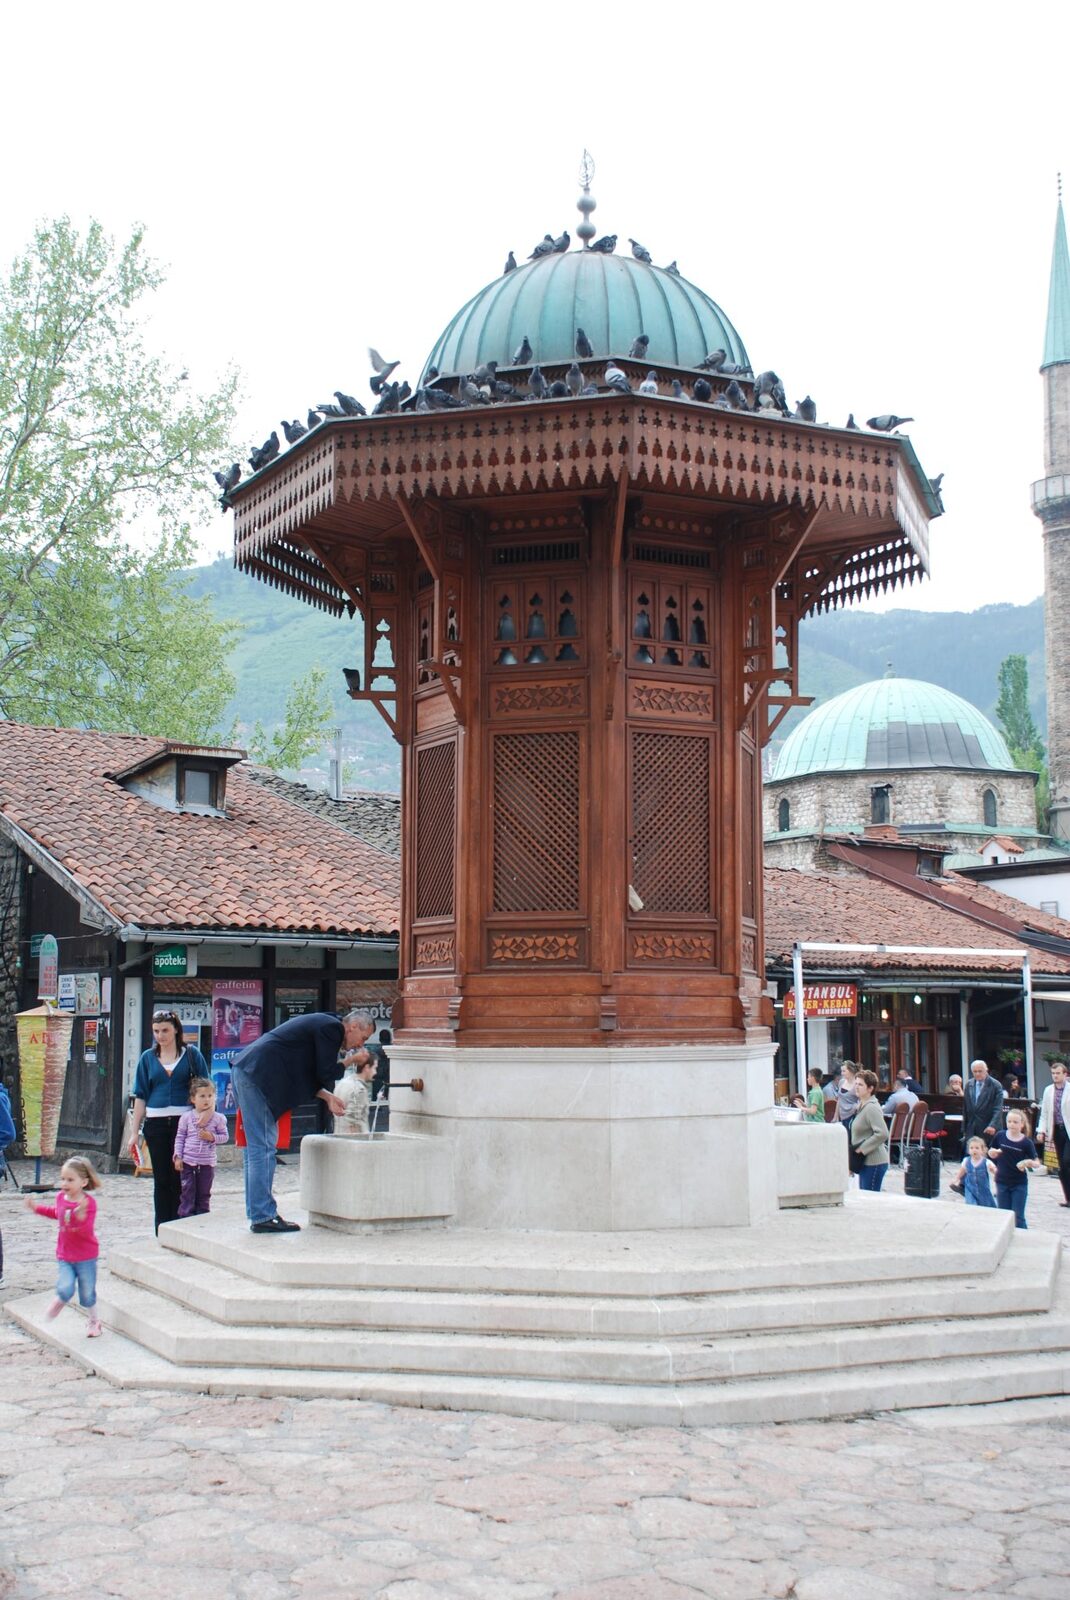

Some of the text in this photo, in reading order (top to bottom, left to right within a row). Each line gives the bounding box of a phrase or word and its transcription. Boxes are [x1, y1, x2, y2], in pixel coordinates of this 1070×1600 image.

[154, 953, 186, 967] apoteka
[215, 980, 256, 989] caffetin
[802, 985, 851, 999] STANBUL
[823, 998, 853, 1009] KEBAP
